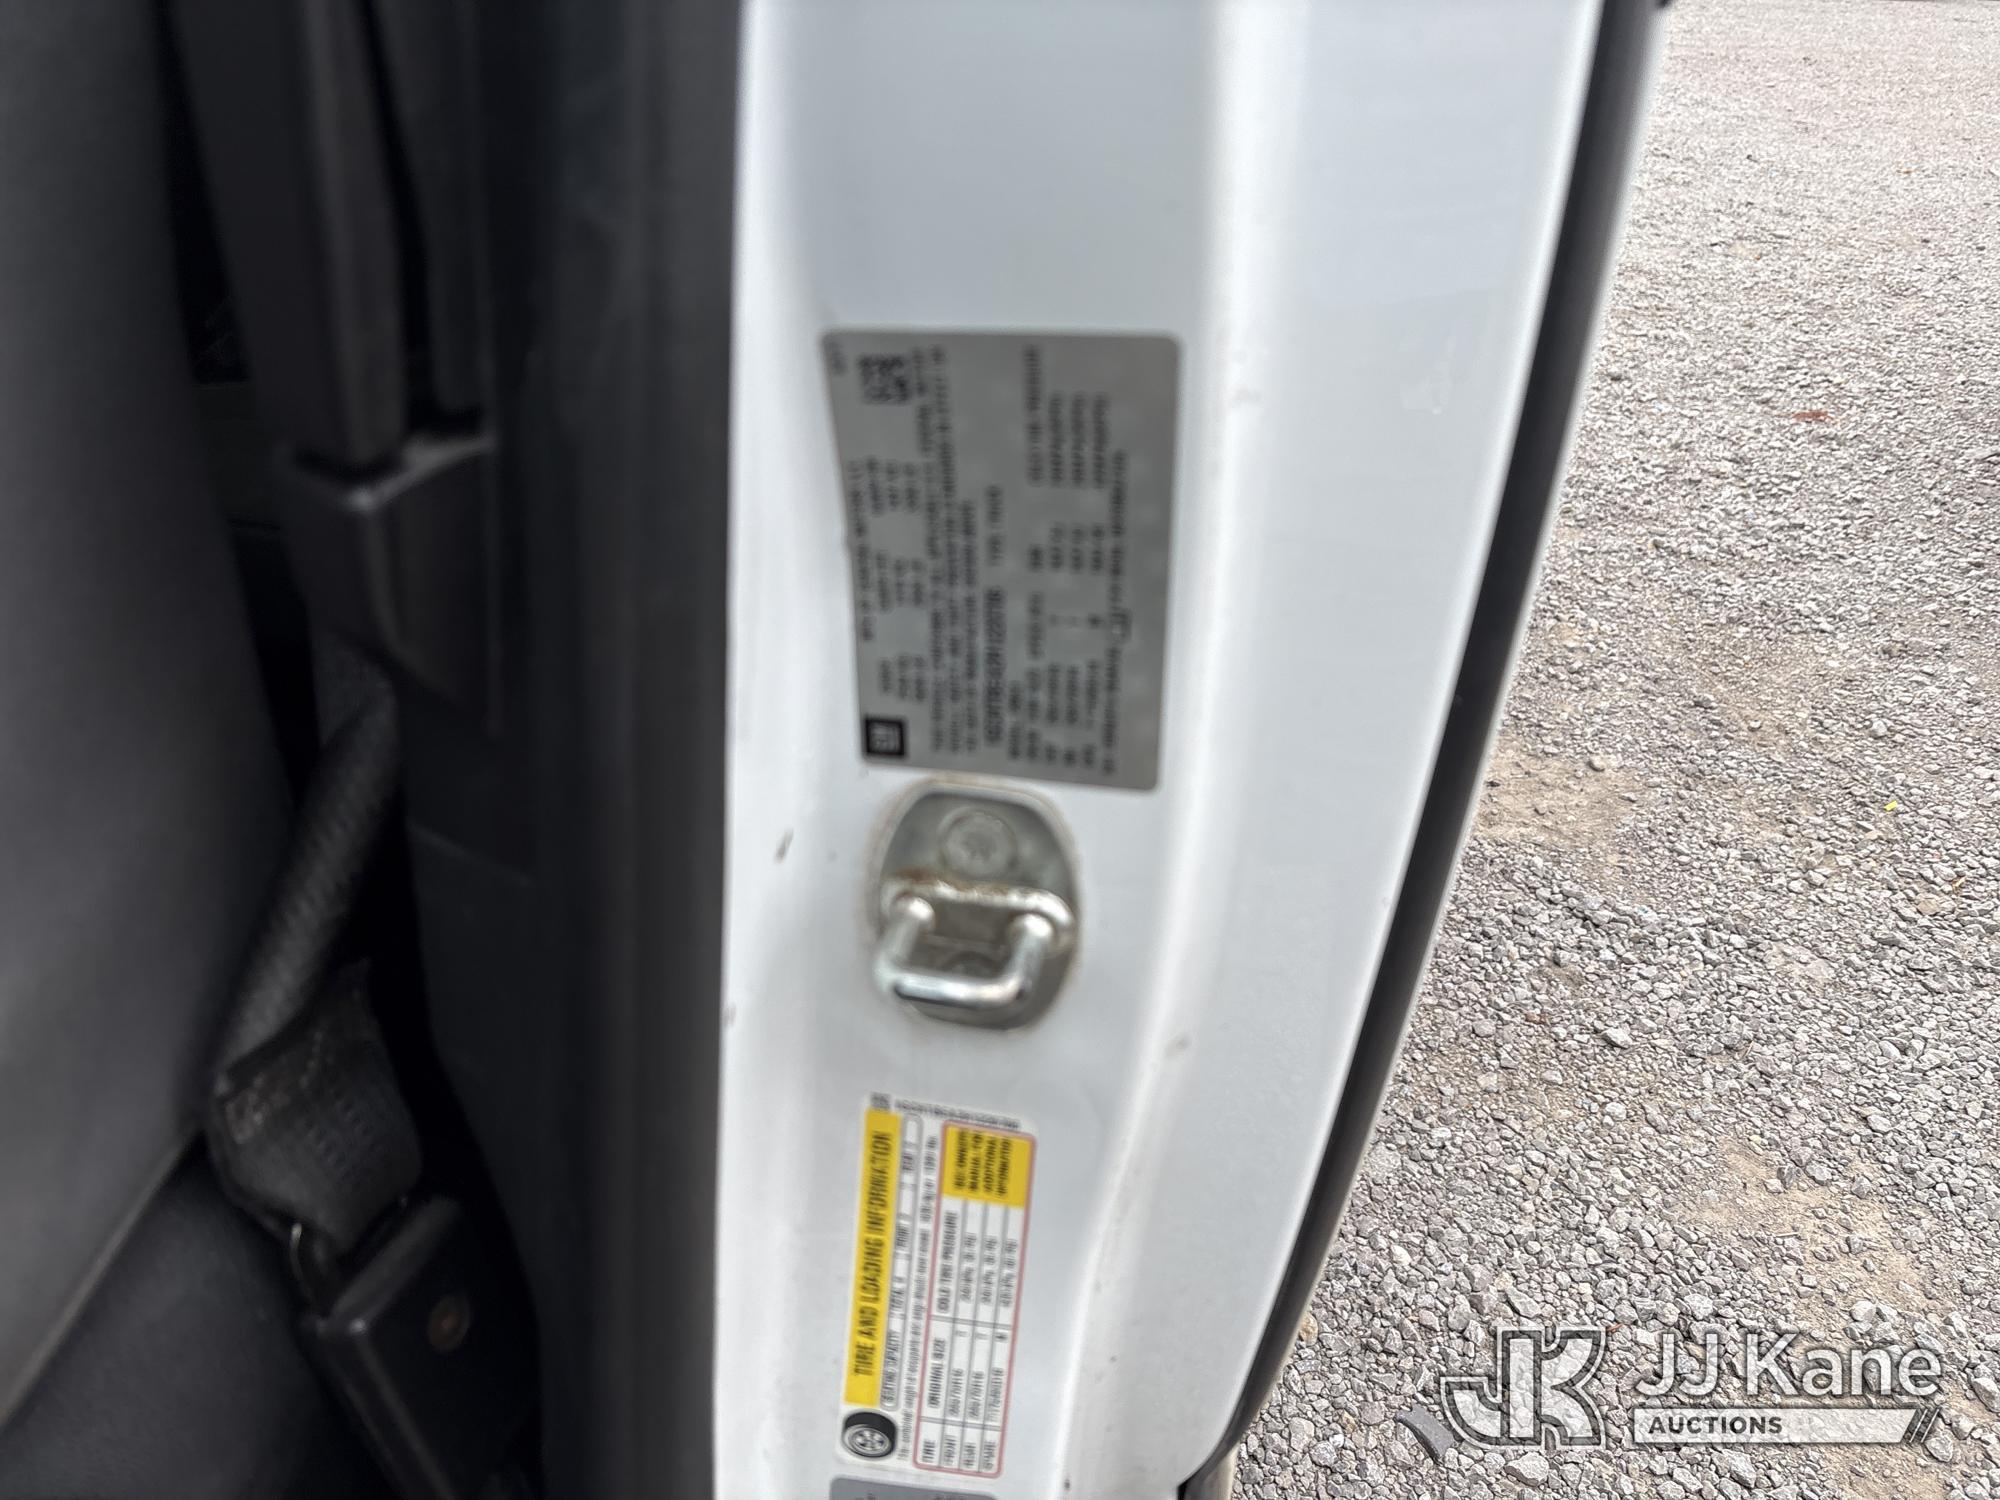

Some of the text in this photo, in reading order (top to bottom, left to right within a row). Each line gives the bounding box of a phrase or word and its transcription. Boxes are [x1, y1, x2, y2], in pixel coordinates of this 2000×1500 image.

[854, 1131, 891, 1375] TIRE AND LOADING INFORMATION
